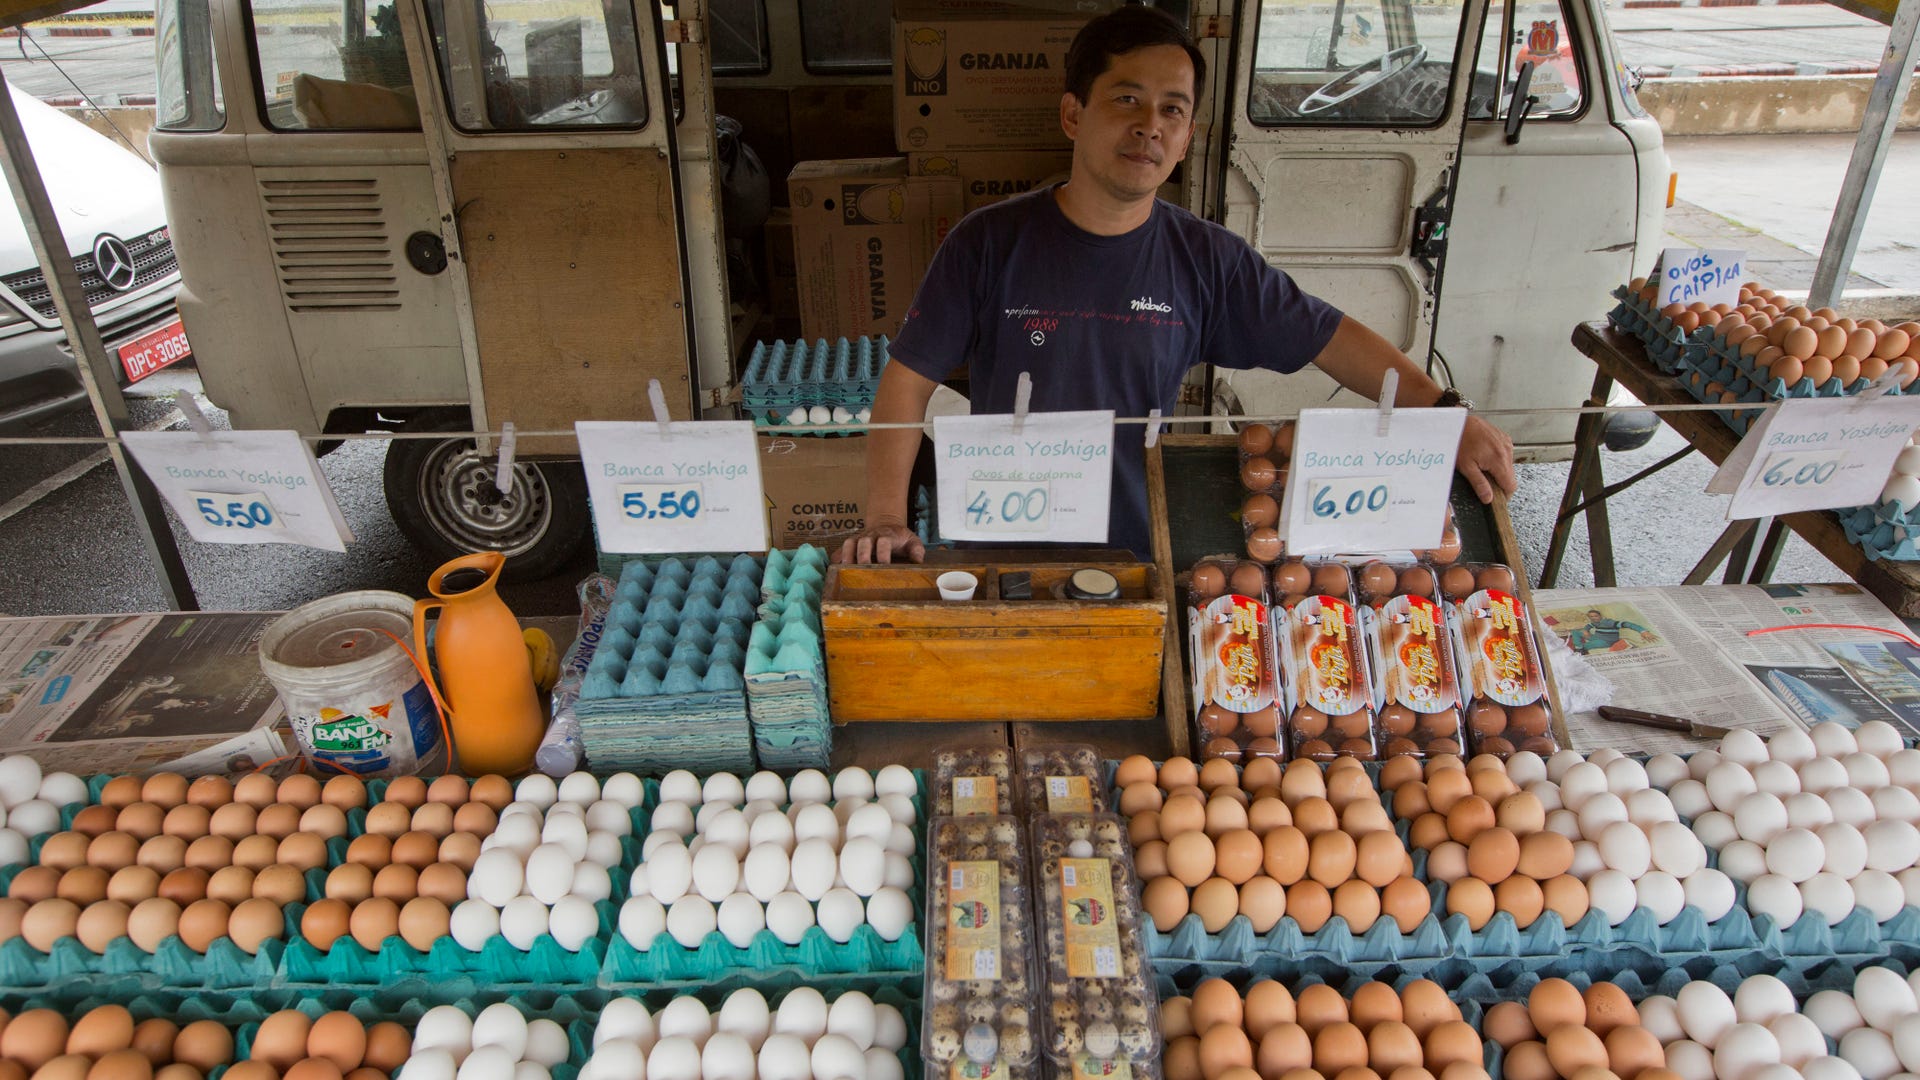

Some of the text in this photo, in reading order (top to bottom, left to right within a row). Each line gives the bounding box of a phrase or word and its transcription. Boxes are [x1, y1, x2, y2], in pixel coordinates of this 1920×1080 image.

[960, 53, 1050, 70] GRANJA
[913, 80, 940, 93] INO
[844, 192, 857, 218] INO
[1669, 254, 1713, 279] OVOS
[867, 237, 886, 321] GRANJA
[1023, 317, 1059, 332] 1988
[1768, 421, 1909, 446] Banca Yoshiga
[948, 439, 1107, 462] Banca Yoshiga
[1304, 449, 1445, 470] Banca Yoshiga
[166, 465, 307, 490] Banca Yoshiga
[604, 460, 748, 480] Banca Yoshiga
[972, 469, 1083, 480] Ovos de codorna
[792, 500, 858, 515] CONTÉM
[787, 518, 865, 531] 360 OVOS
[315, 723, 379, 741] BAND
[362, 733, 387, 751] FM
